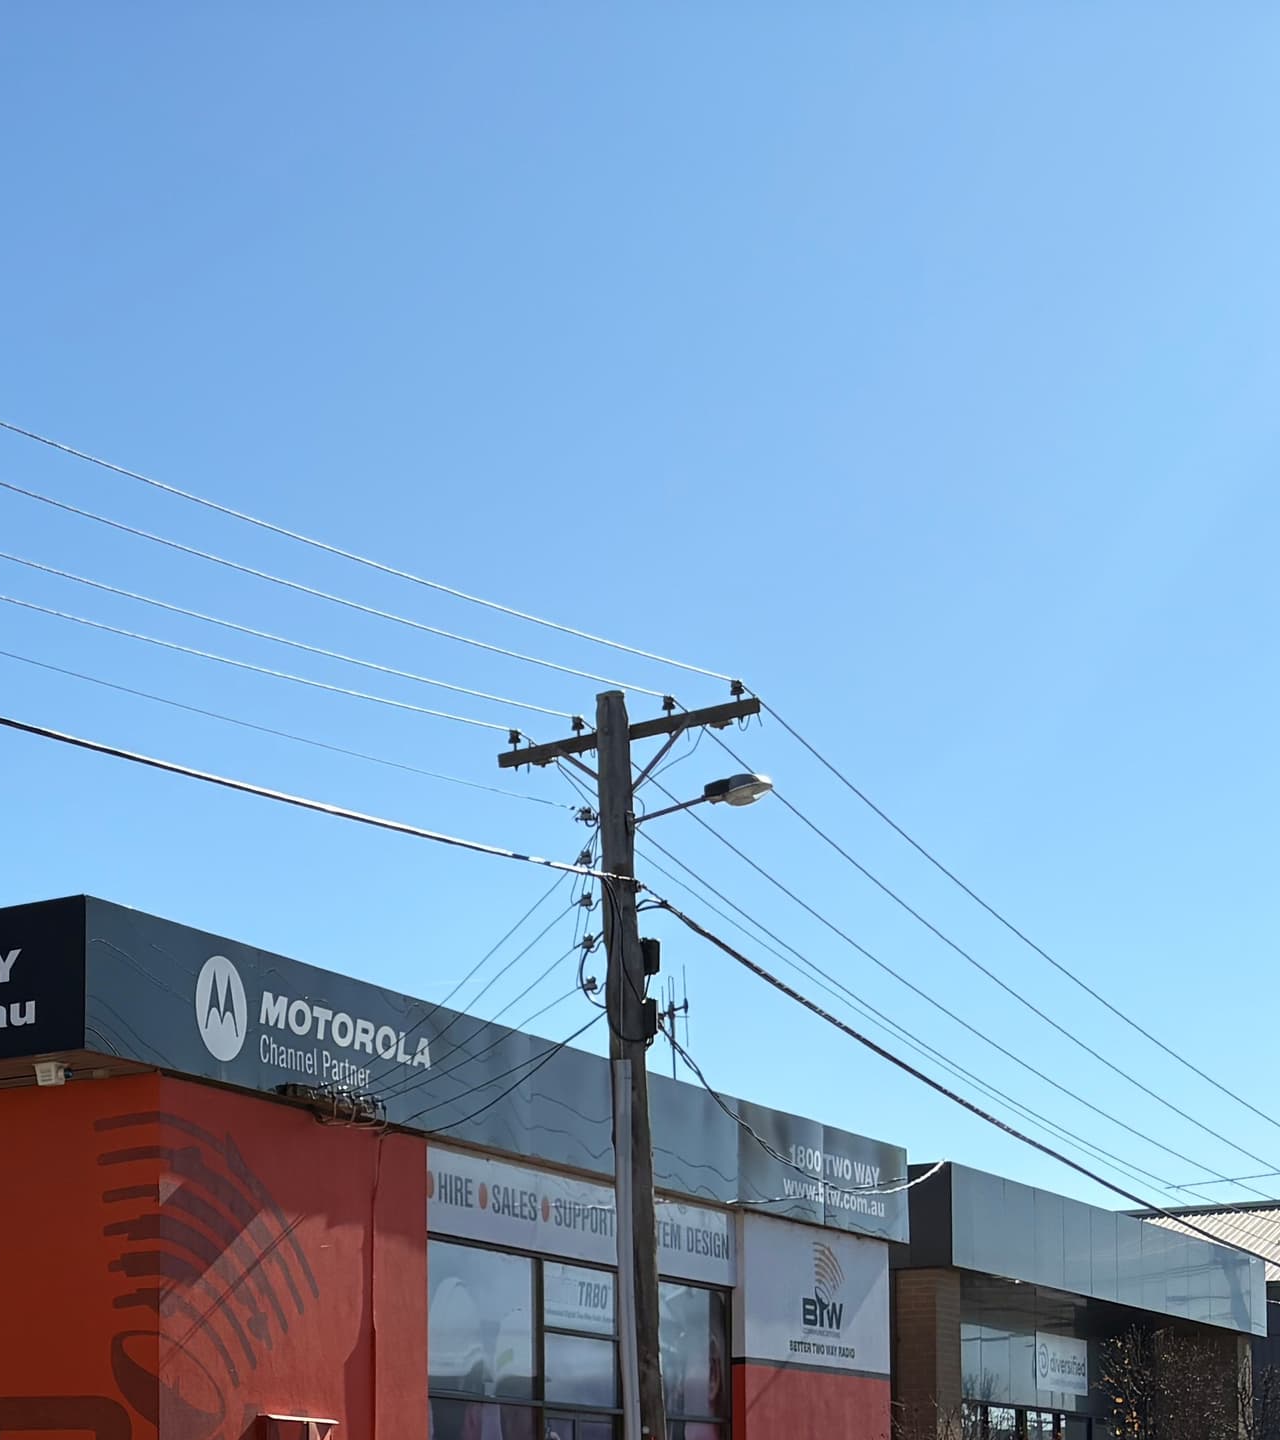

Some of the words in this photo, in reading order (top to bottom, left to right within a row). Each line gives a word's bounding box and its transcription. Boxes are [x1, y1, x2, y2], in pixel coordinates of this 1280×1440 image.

[259, 990, 432, 1070] MOTOROLA
[259, 1033, 318, 1076] Channel
[322, 1049, 371, 1089] Partner
[790, 1144, 821, 1173] 1800
[823, 1153, 852, 1180] TWO
[854, 1162, 880, 1187] WAY
[438, 1172, 474, 1209] HIRE
[491, 1184, 538, 1222] SALES
[554, 1197, 616, 1238] SUPPORT
[687, 1226, 730, 1260] DESIGN
[783, 1178, 886, 1218] www.btw.com.au
[802, 1286, 844, 1330] BTW
